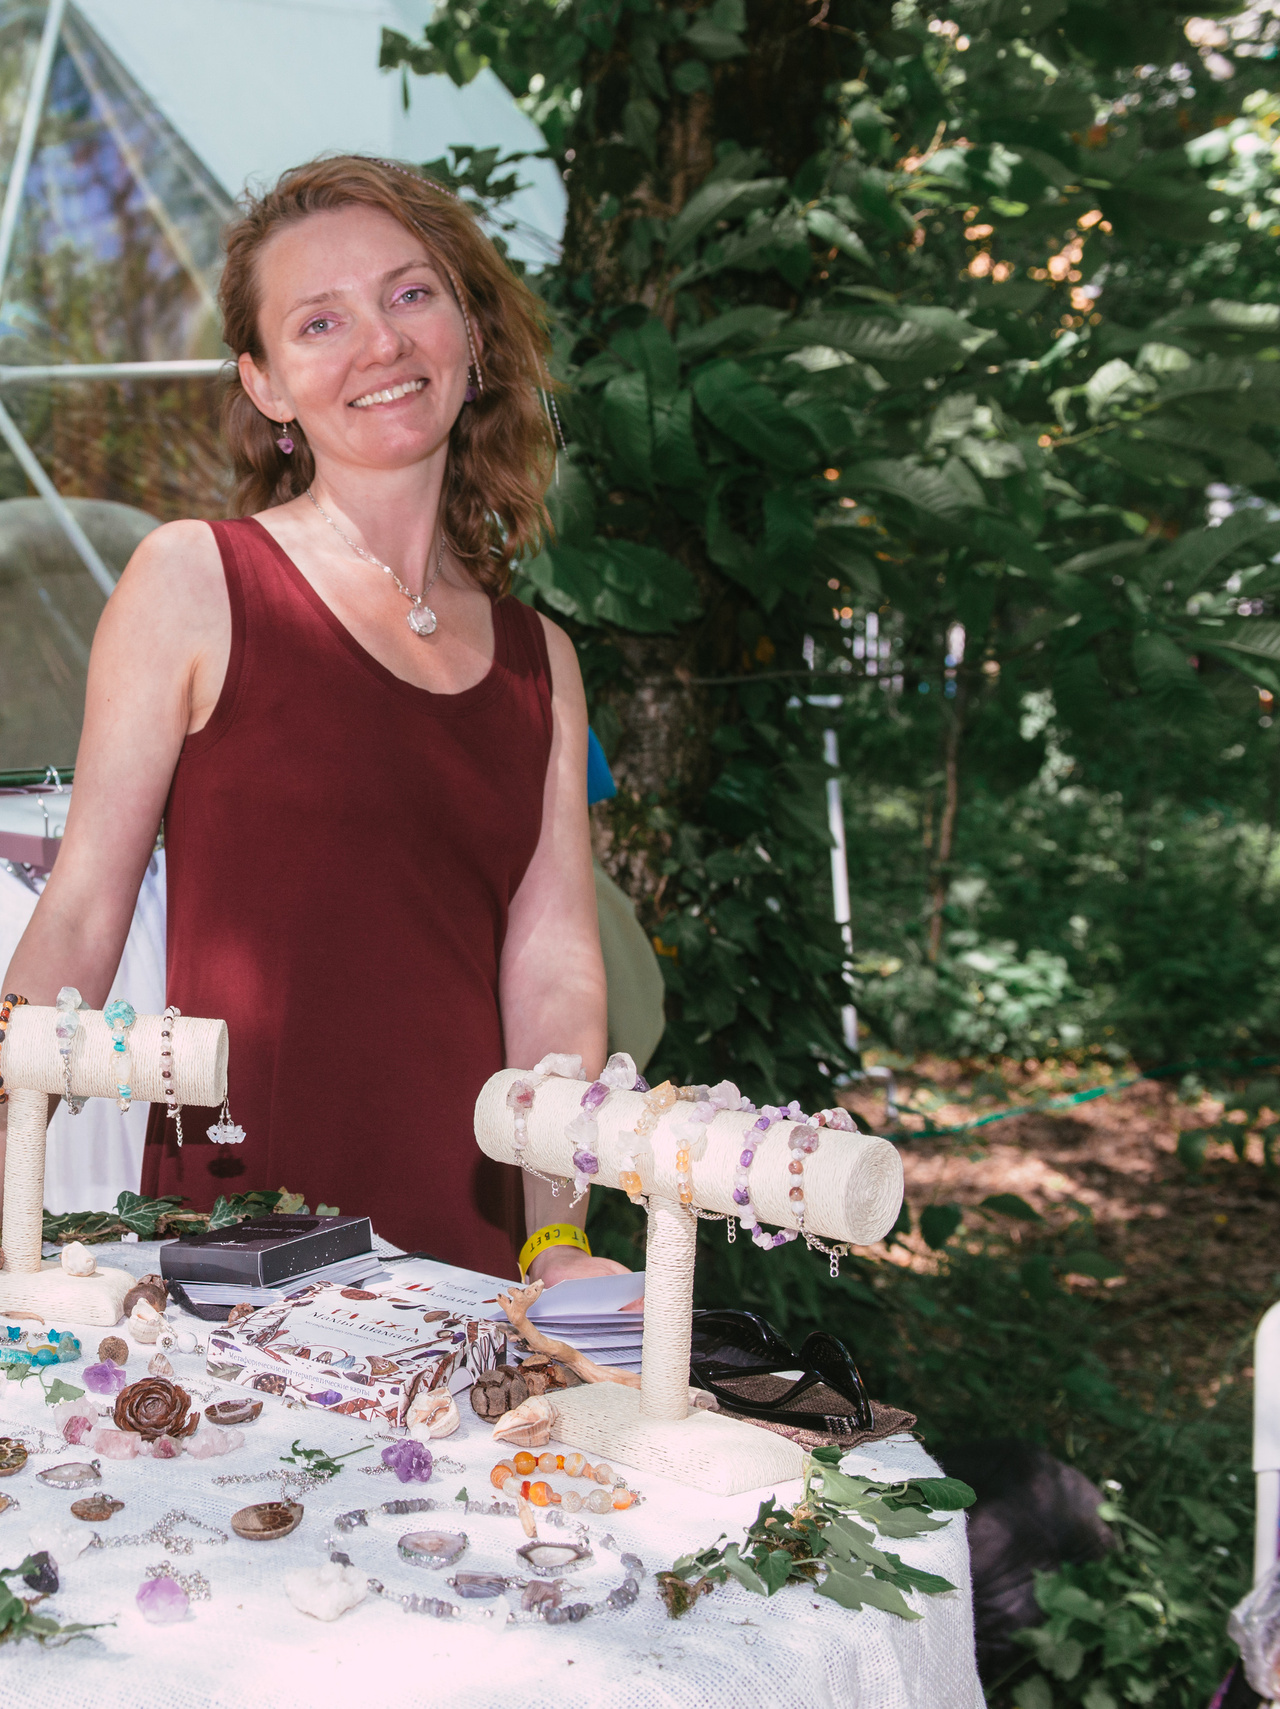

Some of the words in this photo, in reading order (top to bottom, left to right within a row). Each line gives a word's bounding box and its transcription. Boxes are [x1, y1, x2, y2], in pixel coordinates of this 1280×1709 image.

[530, 1229, 560, 1252] СВЕТ
[308, 1311, 355, 1327] Мамы
[358, 1323, 420, 1343] Шамана
[228, 1351, 282, 1374] Метафорические
[281, 1367, 349, 1391] арт-терапевтические
[349, 1385, 371, 1397] карты
